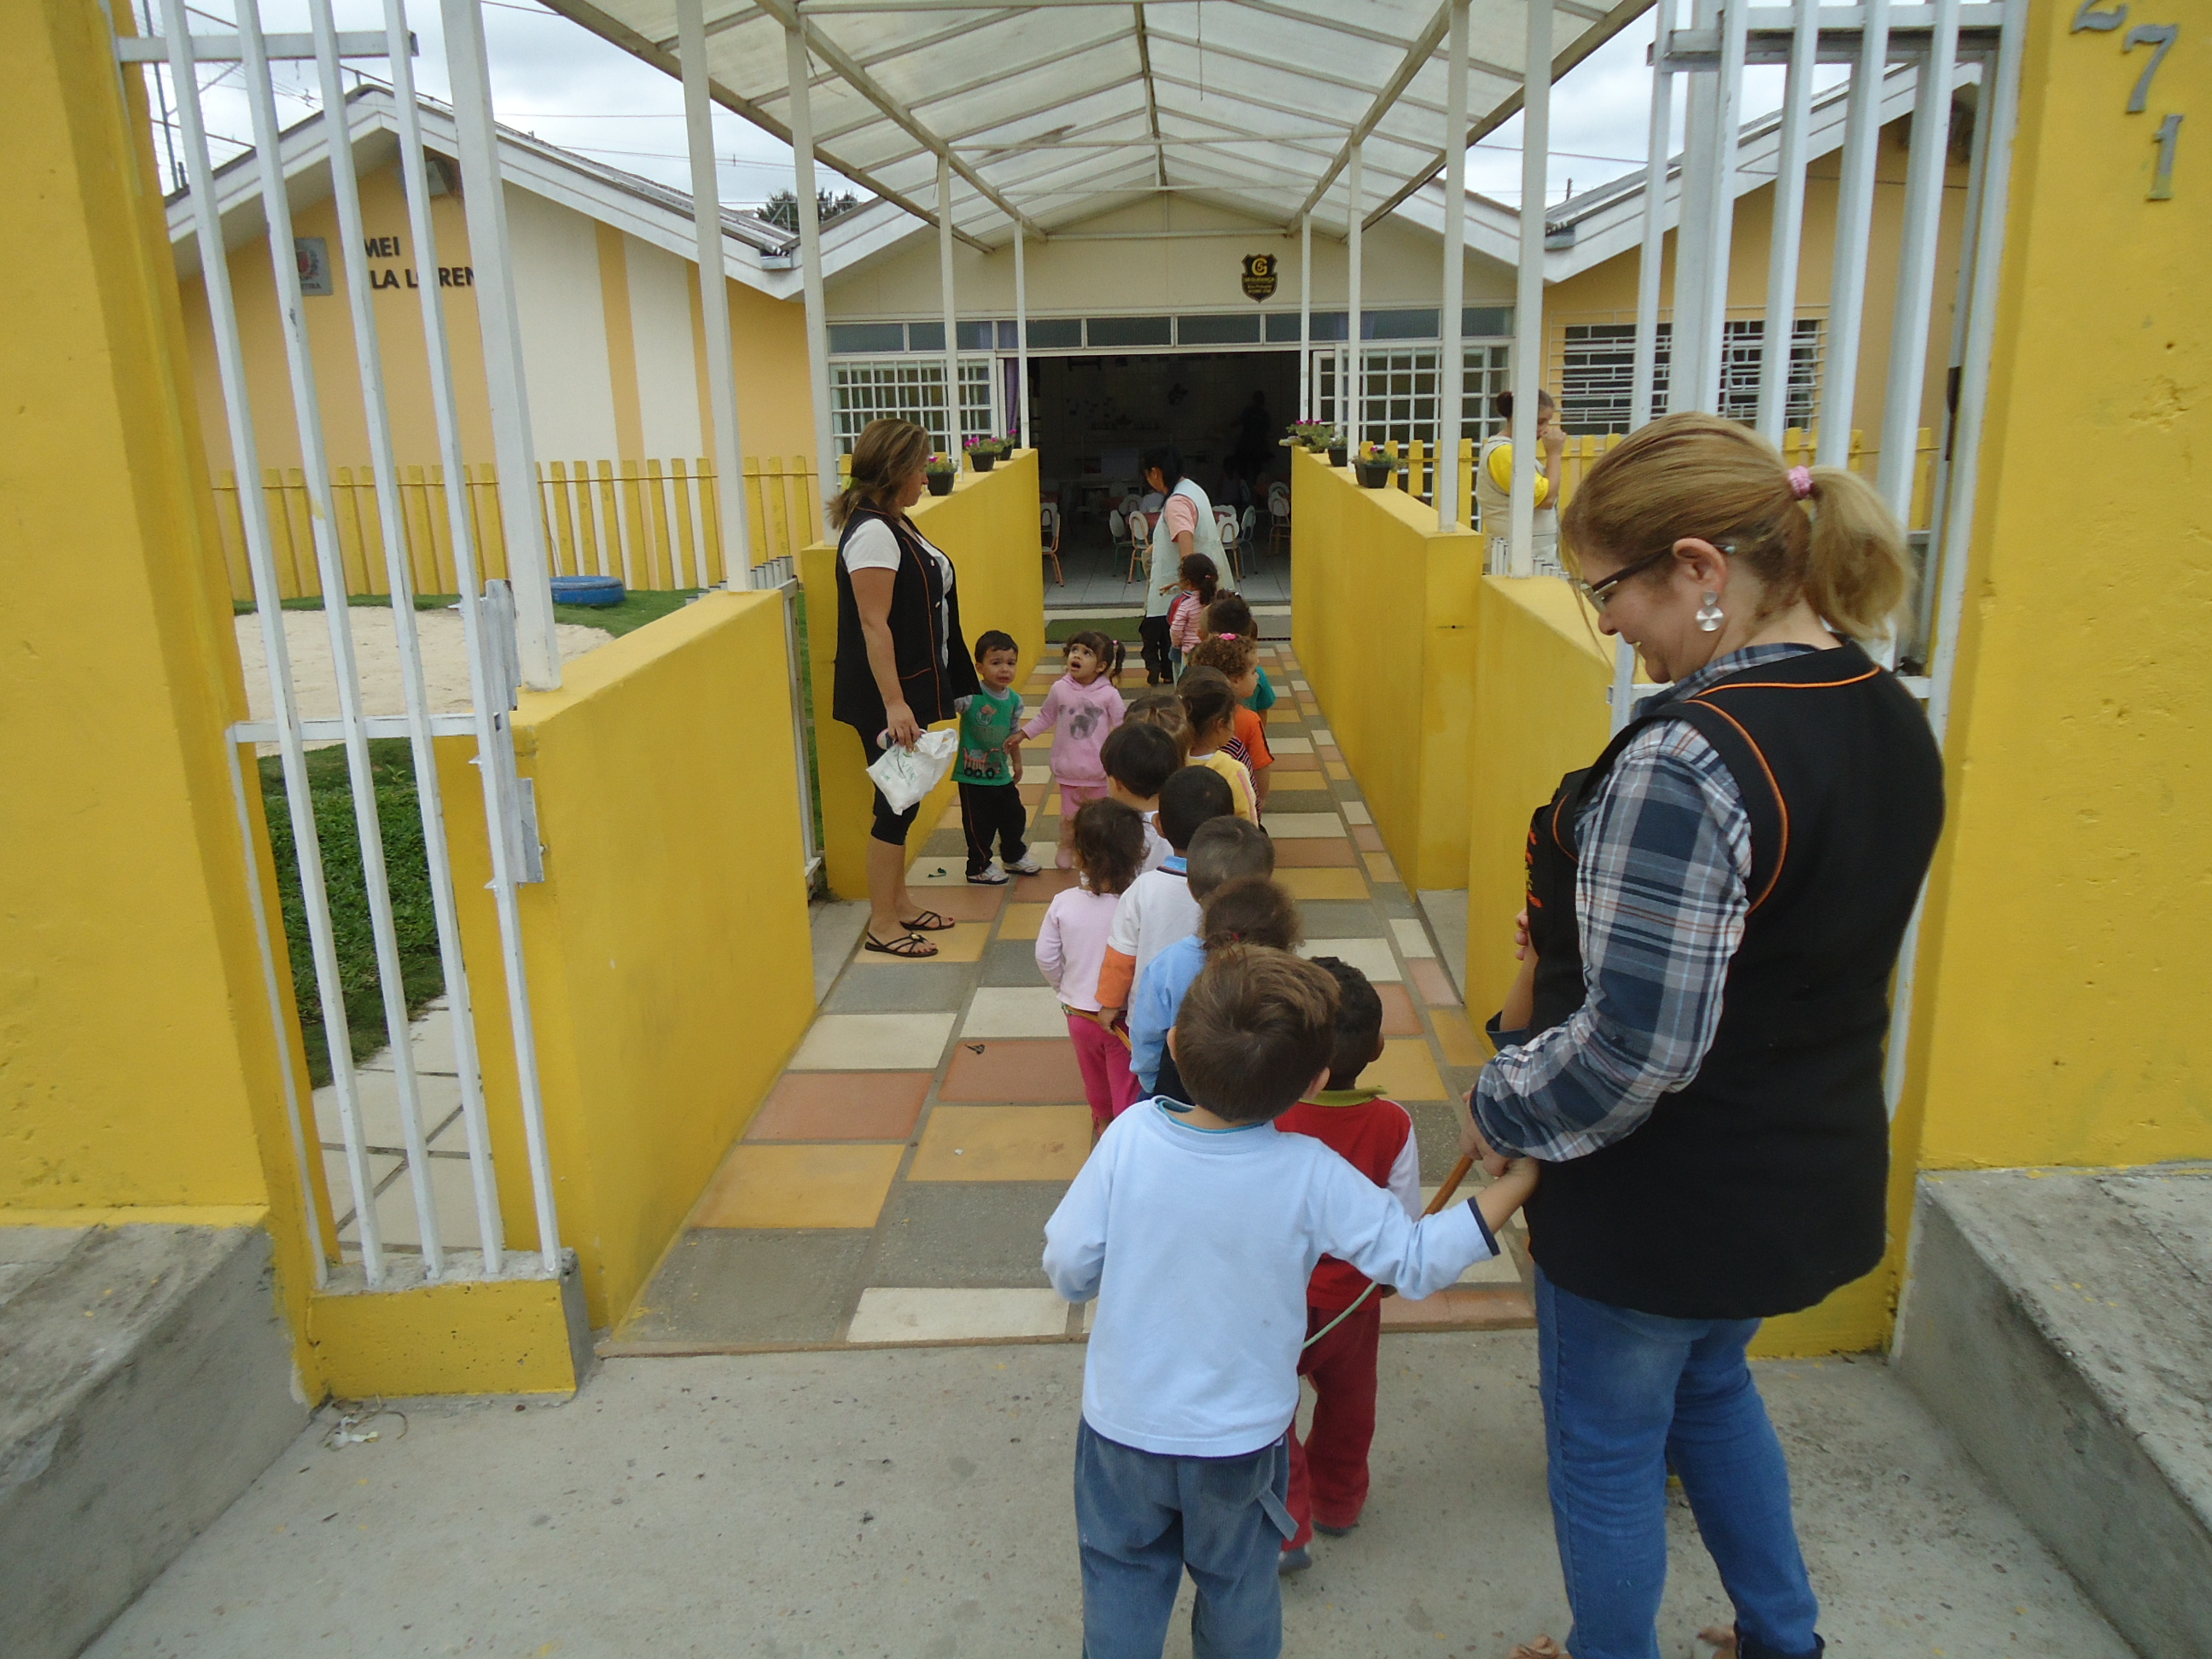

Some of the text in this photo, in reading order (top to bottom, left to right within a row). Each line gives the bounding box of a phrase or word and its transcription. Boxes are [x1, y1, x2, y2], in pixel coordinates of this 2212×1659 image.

[364, 236, 400, 258] MEI
[370, 266, 474, 288] LA LREN
